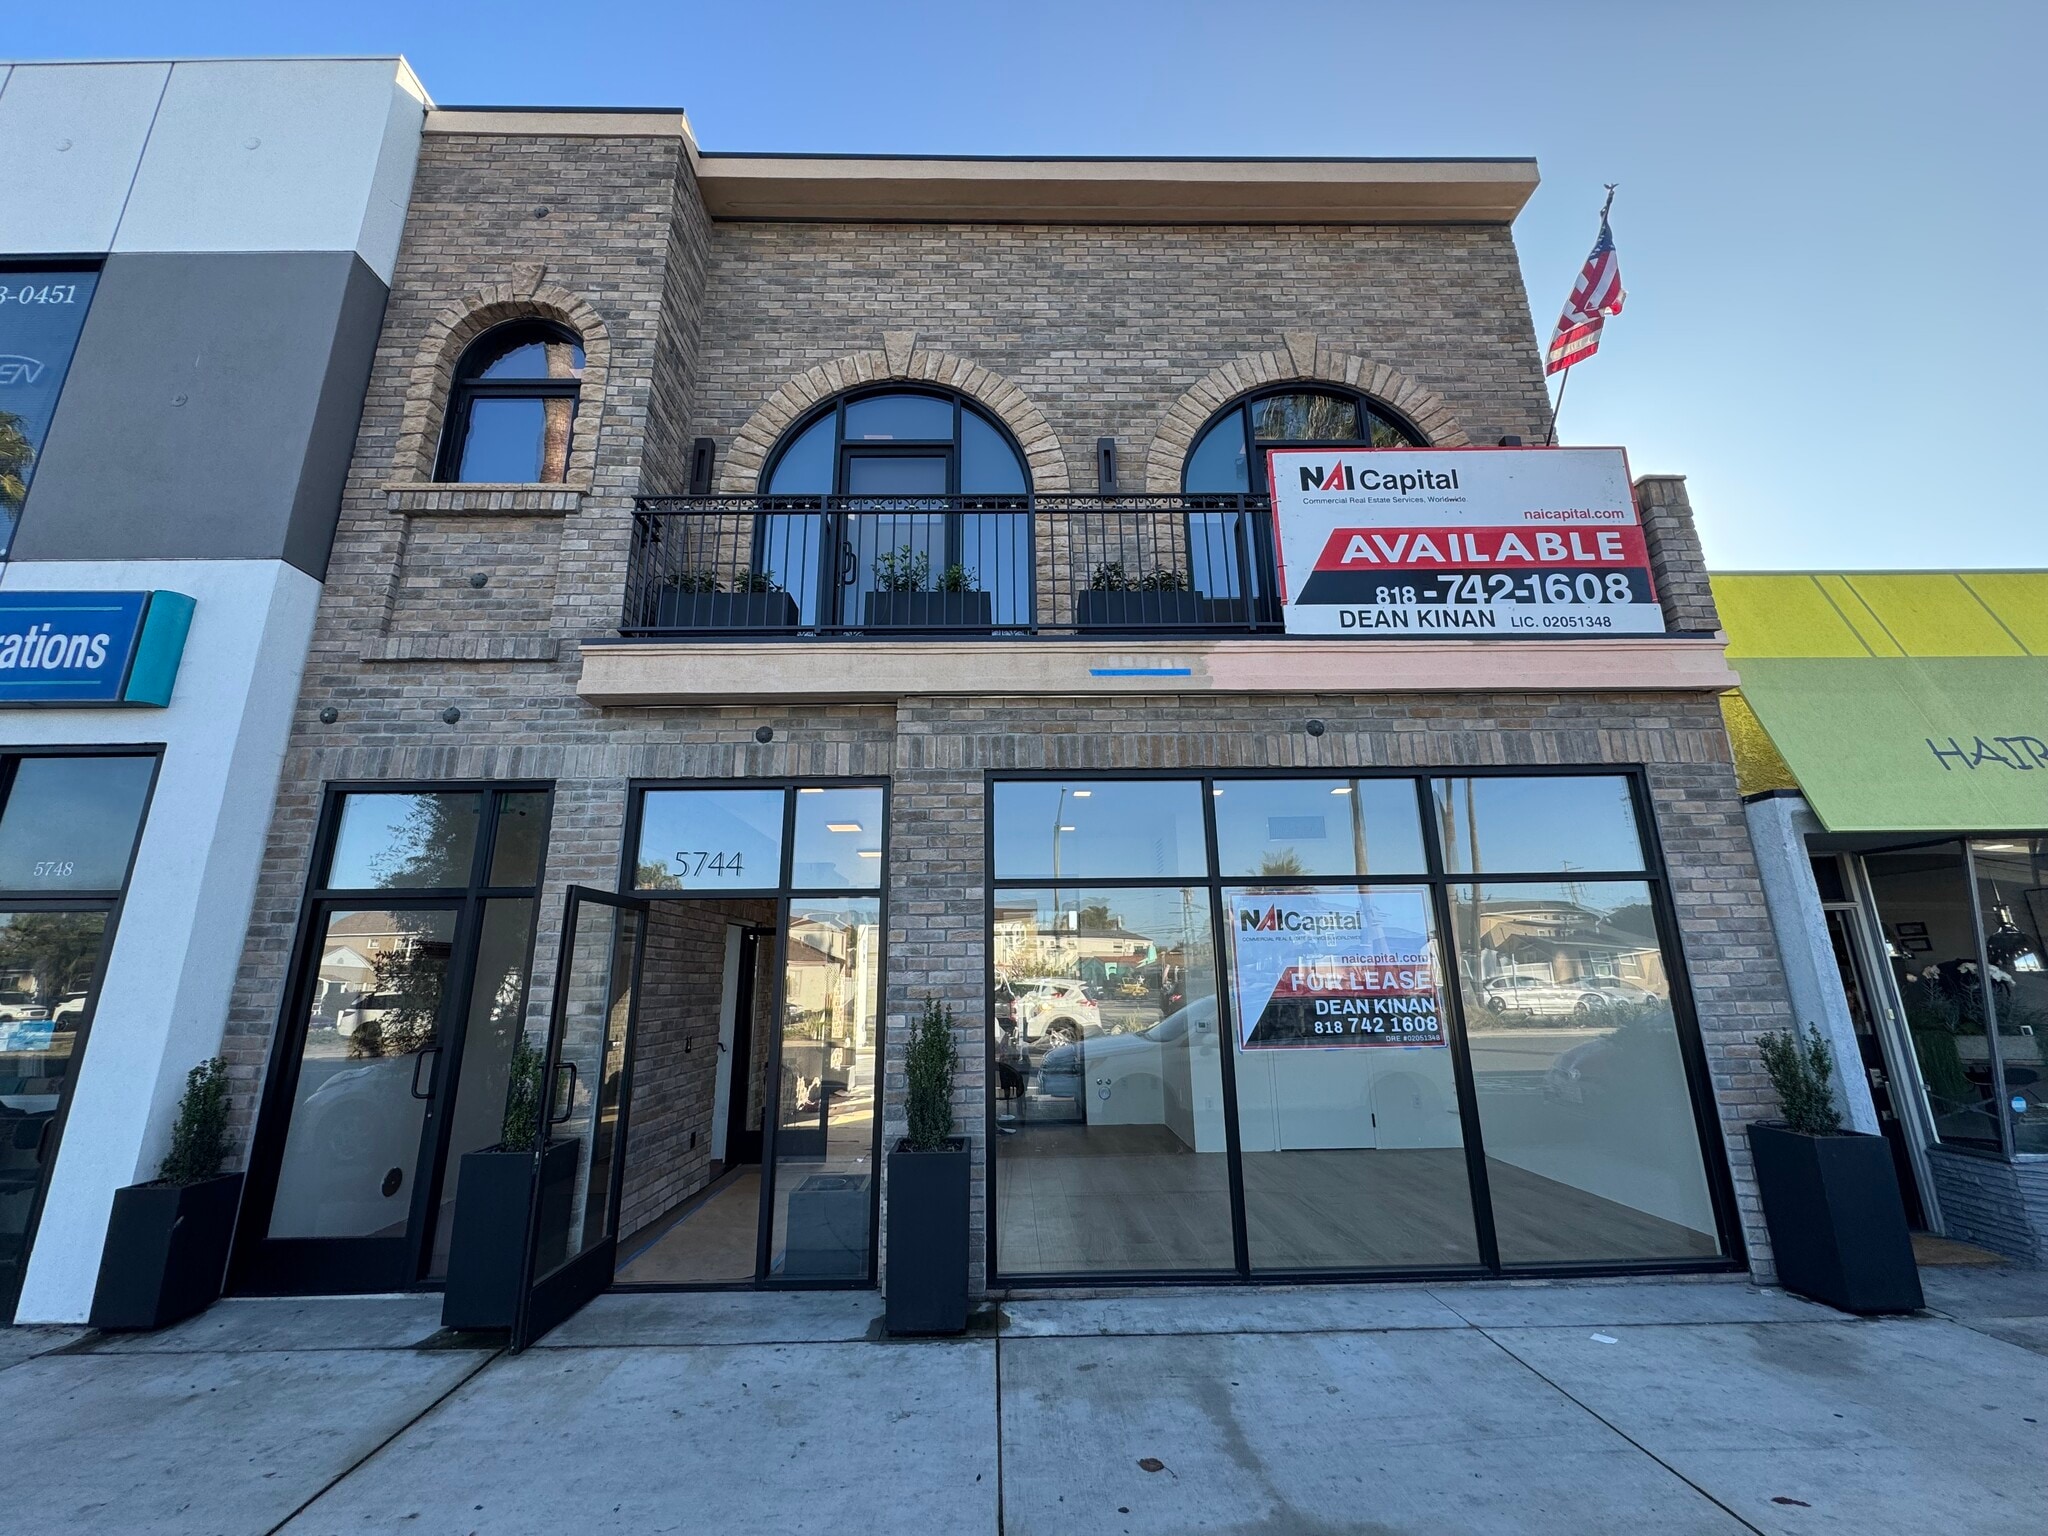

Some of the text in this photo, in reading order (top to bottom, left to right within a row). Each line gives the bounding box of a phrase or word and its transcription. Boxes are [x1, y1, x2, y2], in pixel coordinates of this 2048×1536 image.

[1359, 469, 1460, 495] Capital
[1302, 497, 1348, 505] Commercial
[1367, 496, 1391, 504] Estate
[1396, 496, 1426, 504] Services,
[1523, 508, 1625, 522] naicapital.com
[1340, 532, 1625, 564] AVAILABLE
[1339, 609, 1612, 629] DEAN KINAN LIC. 02051348
[0, 622, 110, 670] ations
[1925, 736, 2048, 770] HAIR
[33, 861, 74, 877] 5748
[673, 851, 744, 878] 5744
[1284, 911, 1362, 936] Capital
[1341, 952, 1429, 965] naicapital.com
[1290, 970, 1433, 991] FOR LEASE
[1314, 997, 1436, 1015] DEAN KINAN
[1314, 1015, 1439, 1034] 818 742 1608
